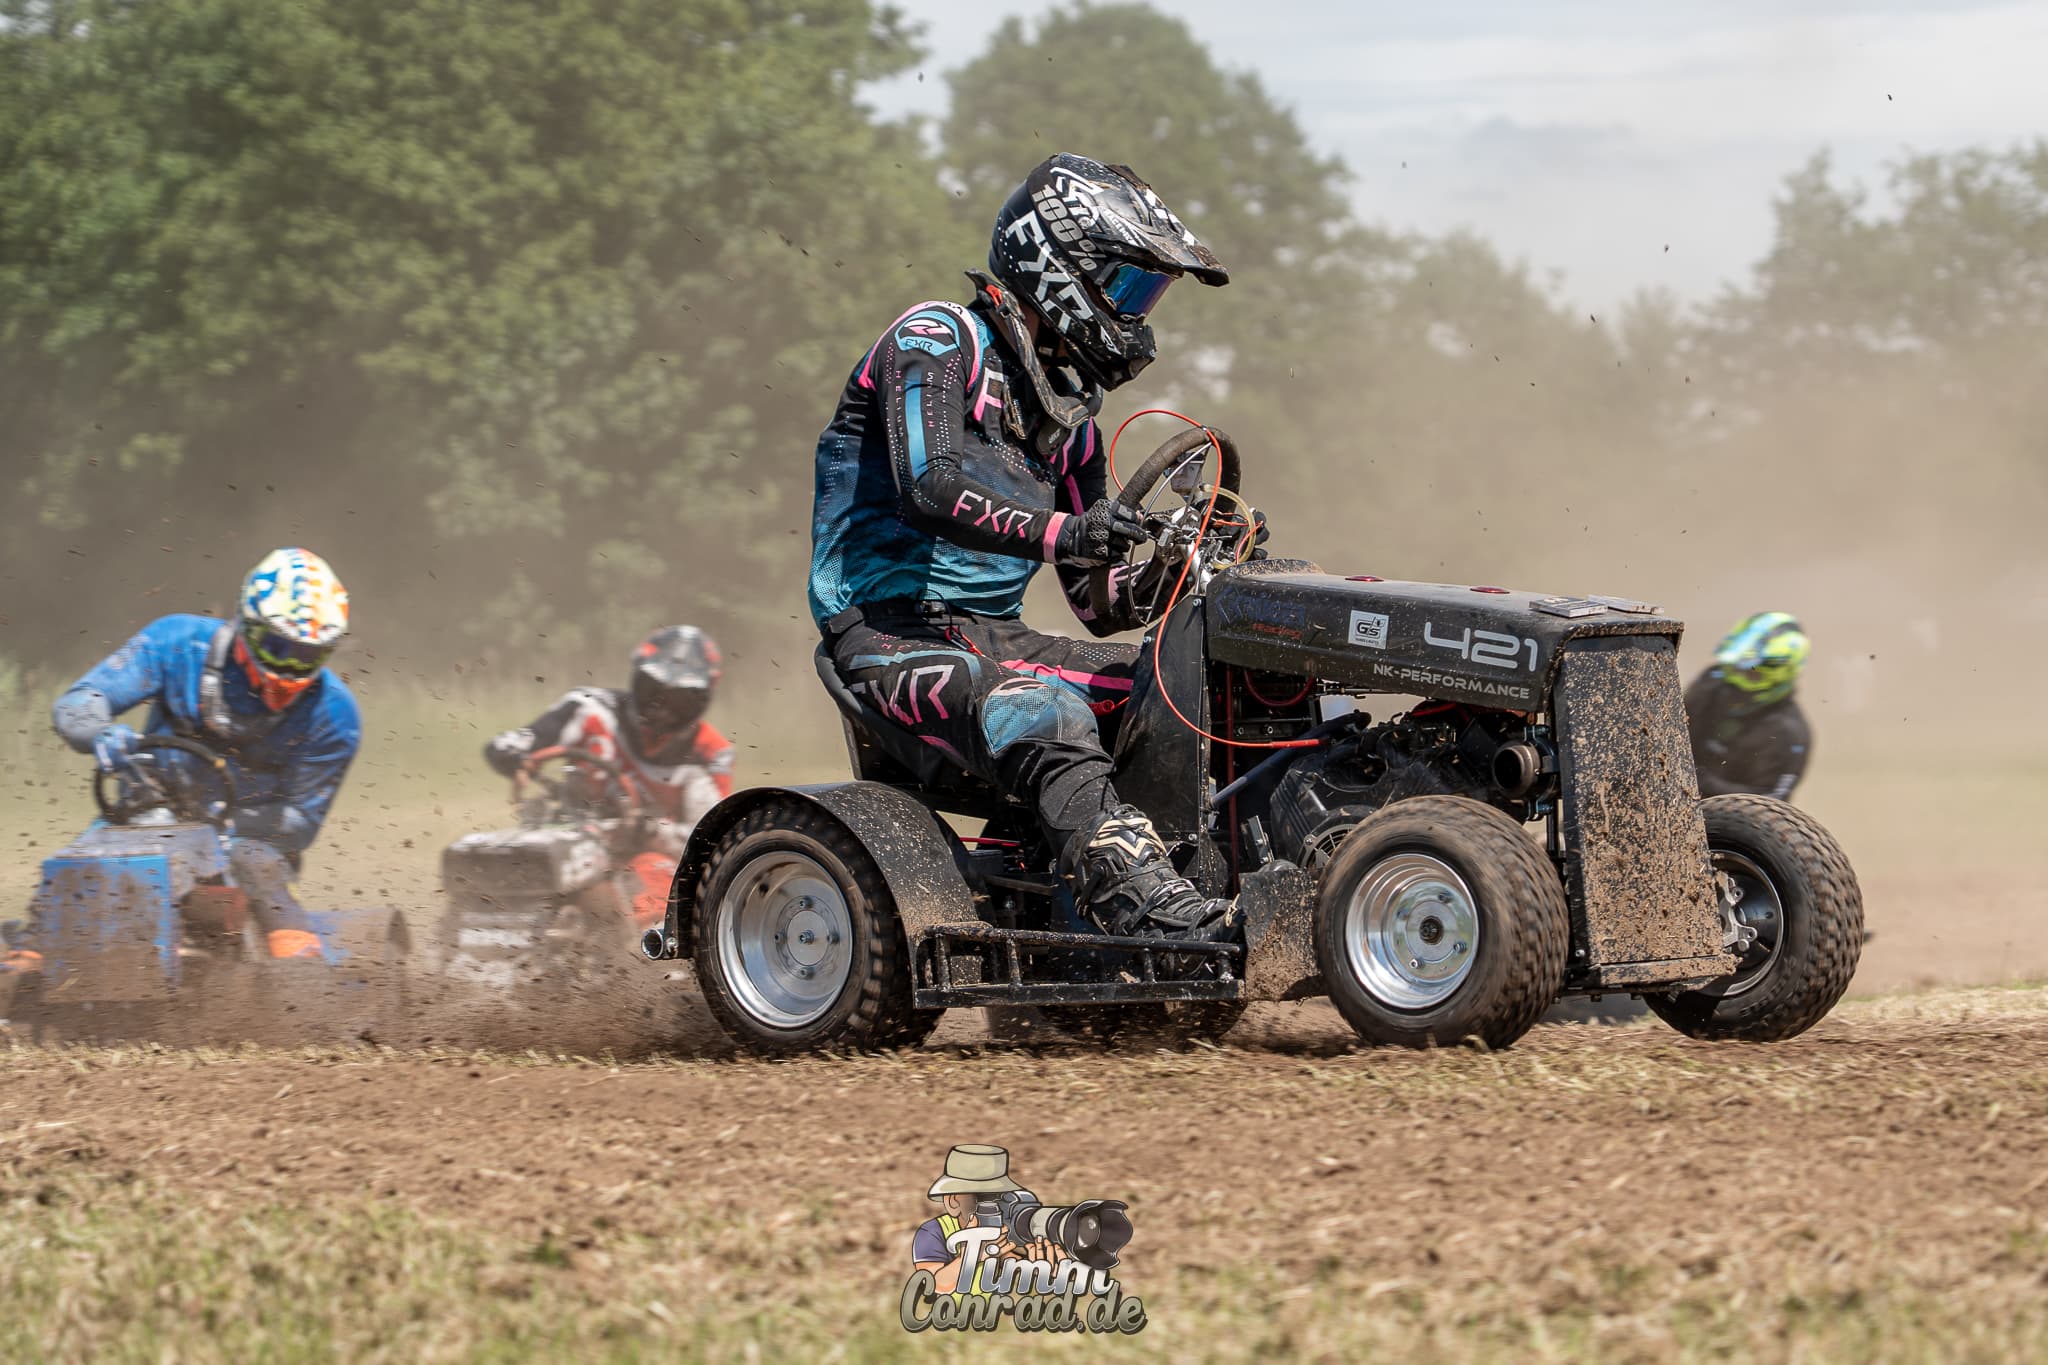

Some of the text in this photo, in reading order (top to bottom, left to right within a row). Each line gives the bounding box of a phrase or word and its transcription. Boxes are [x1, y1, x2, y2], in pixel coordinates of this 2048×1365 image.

[1032, 184, 1107, 272] 100%
[1005, 210, 1094, 334] FXR
[905, 338, 933, 351] FXR
[952, 489, 1034, 539] FXR
[1424, 621, 1538, 672] 421
[1373, 663, 1529, 699] NK-PERFORMANCE
